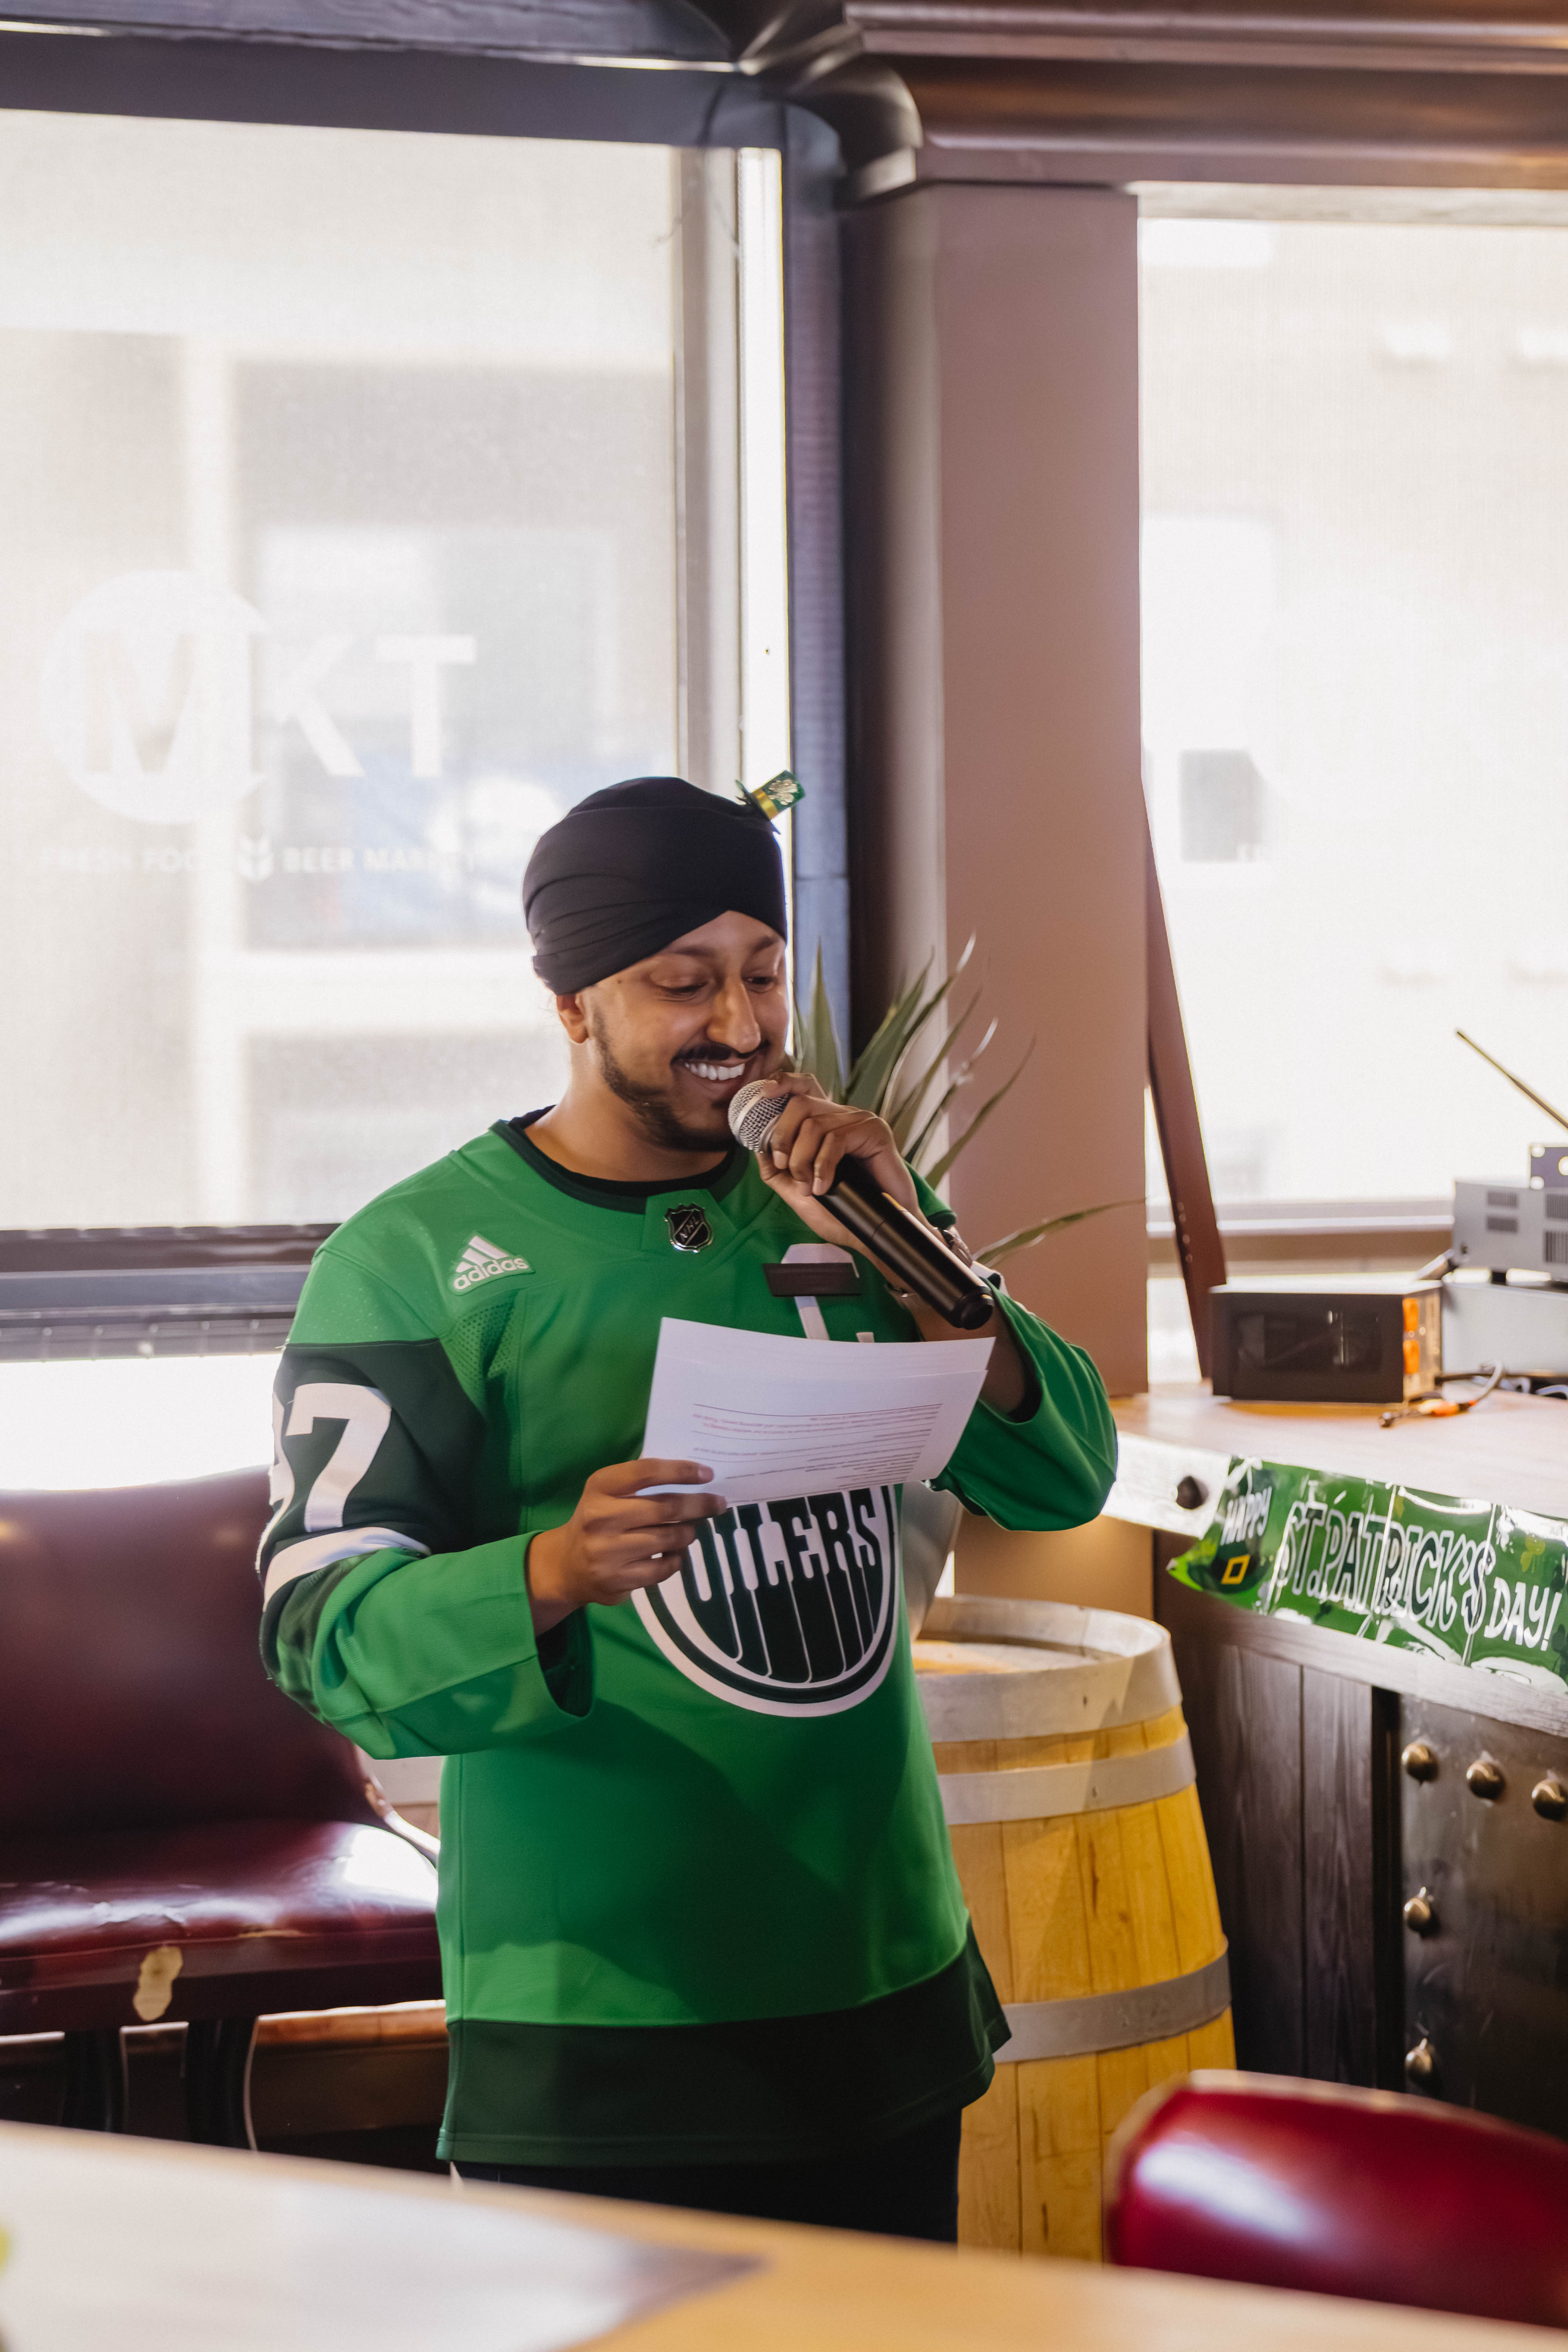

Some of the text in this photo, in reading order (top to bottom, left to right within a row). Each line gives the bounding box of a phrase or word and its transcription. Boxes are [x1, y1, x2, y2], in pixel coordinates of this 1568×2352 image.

[82, 630, 477, 777] MKT
[679, 1216, 700, 1242] NHL
[453, 1257, 529, 1290] adidas
[1220, 1486, 1273, 1546] HAPPY
[1483, 1576, 1563, 1651] DAY!
